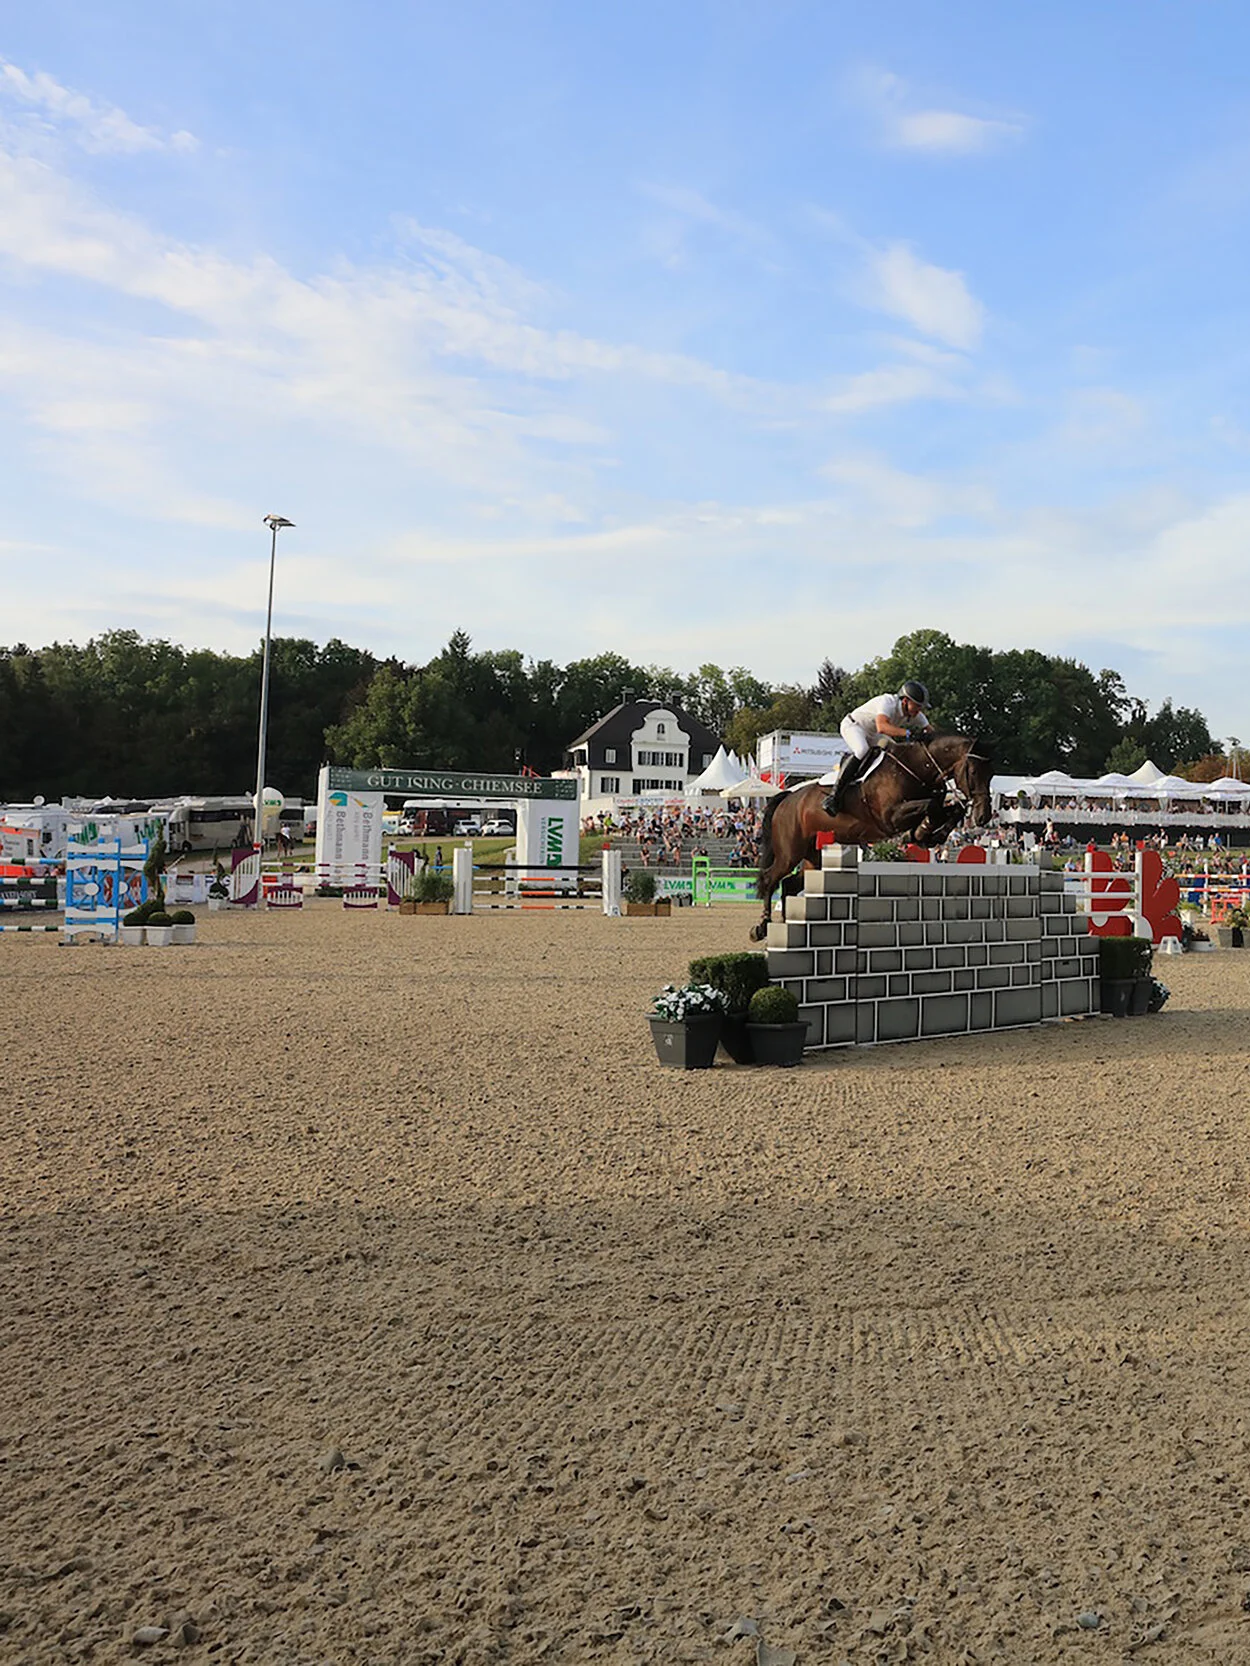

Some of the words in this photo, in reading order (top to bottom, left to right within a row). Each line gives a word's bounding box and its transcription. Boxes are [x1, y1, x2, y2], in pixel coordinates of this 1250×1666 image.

[367, 775, 403, 787] GUT
[407, 777, 453, 790] ISING
[461, 779, 543, 794] CHIEMSEE
[335, 810, 346, 860] Bethmann
[361, 811, 373, 860] Bethmann
[547, 817, 564, 852] LVM
[663, 880, 686, 890] LVM
